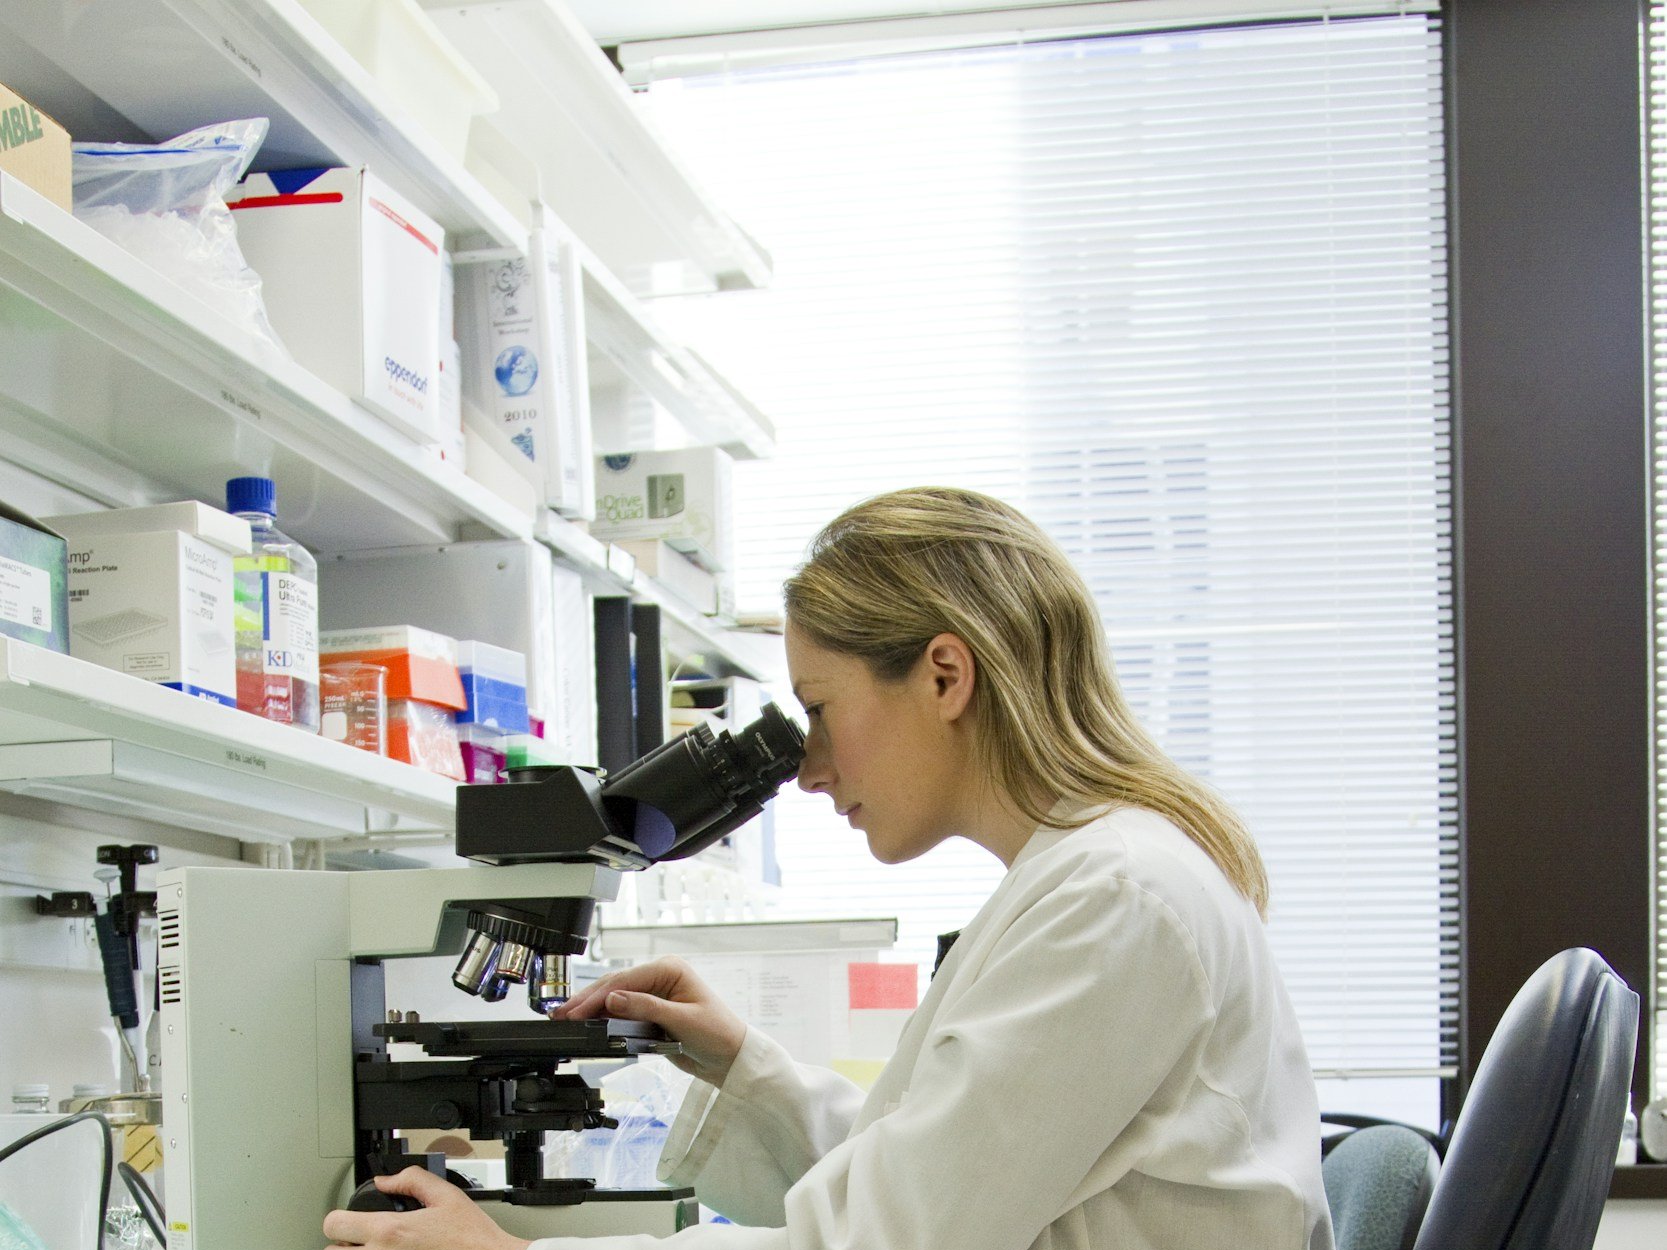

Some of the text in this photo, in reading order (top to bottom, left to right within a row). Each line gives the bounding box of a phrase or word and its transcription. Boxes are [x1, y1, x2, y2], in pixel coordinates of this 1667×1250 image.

[385, 356, 428, 395] eppendorf
[503, 407, 538, 422] 2010
[606, 504, 645, 524] Quad
[73, 566, 101, 574] Reaction
[102, 564, 118, 572] Plate
[755, 731, 776, 761] OLYMPUS
[71, 898, 78, 911] 3
